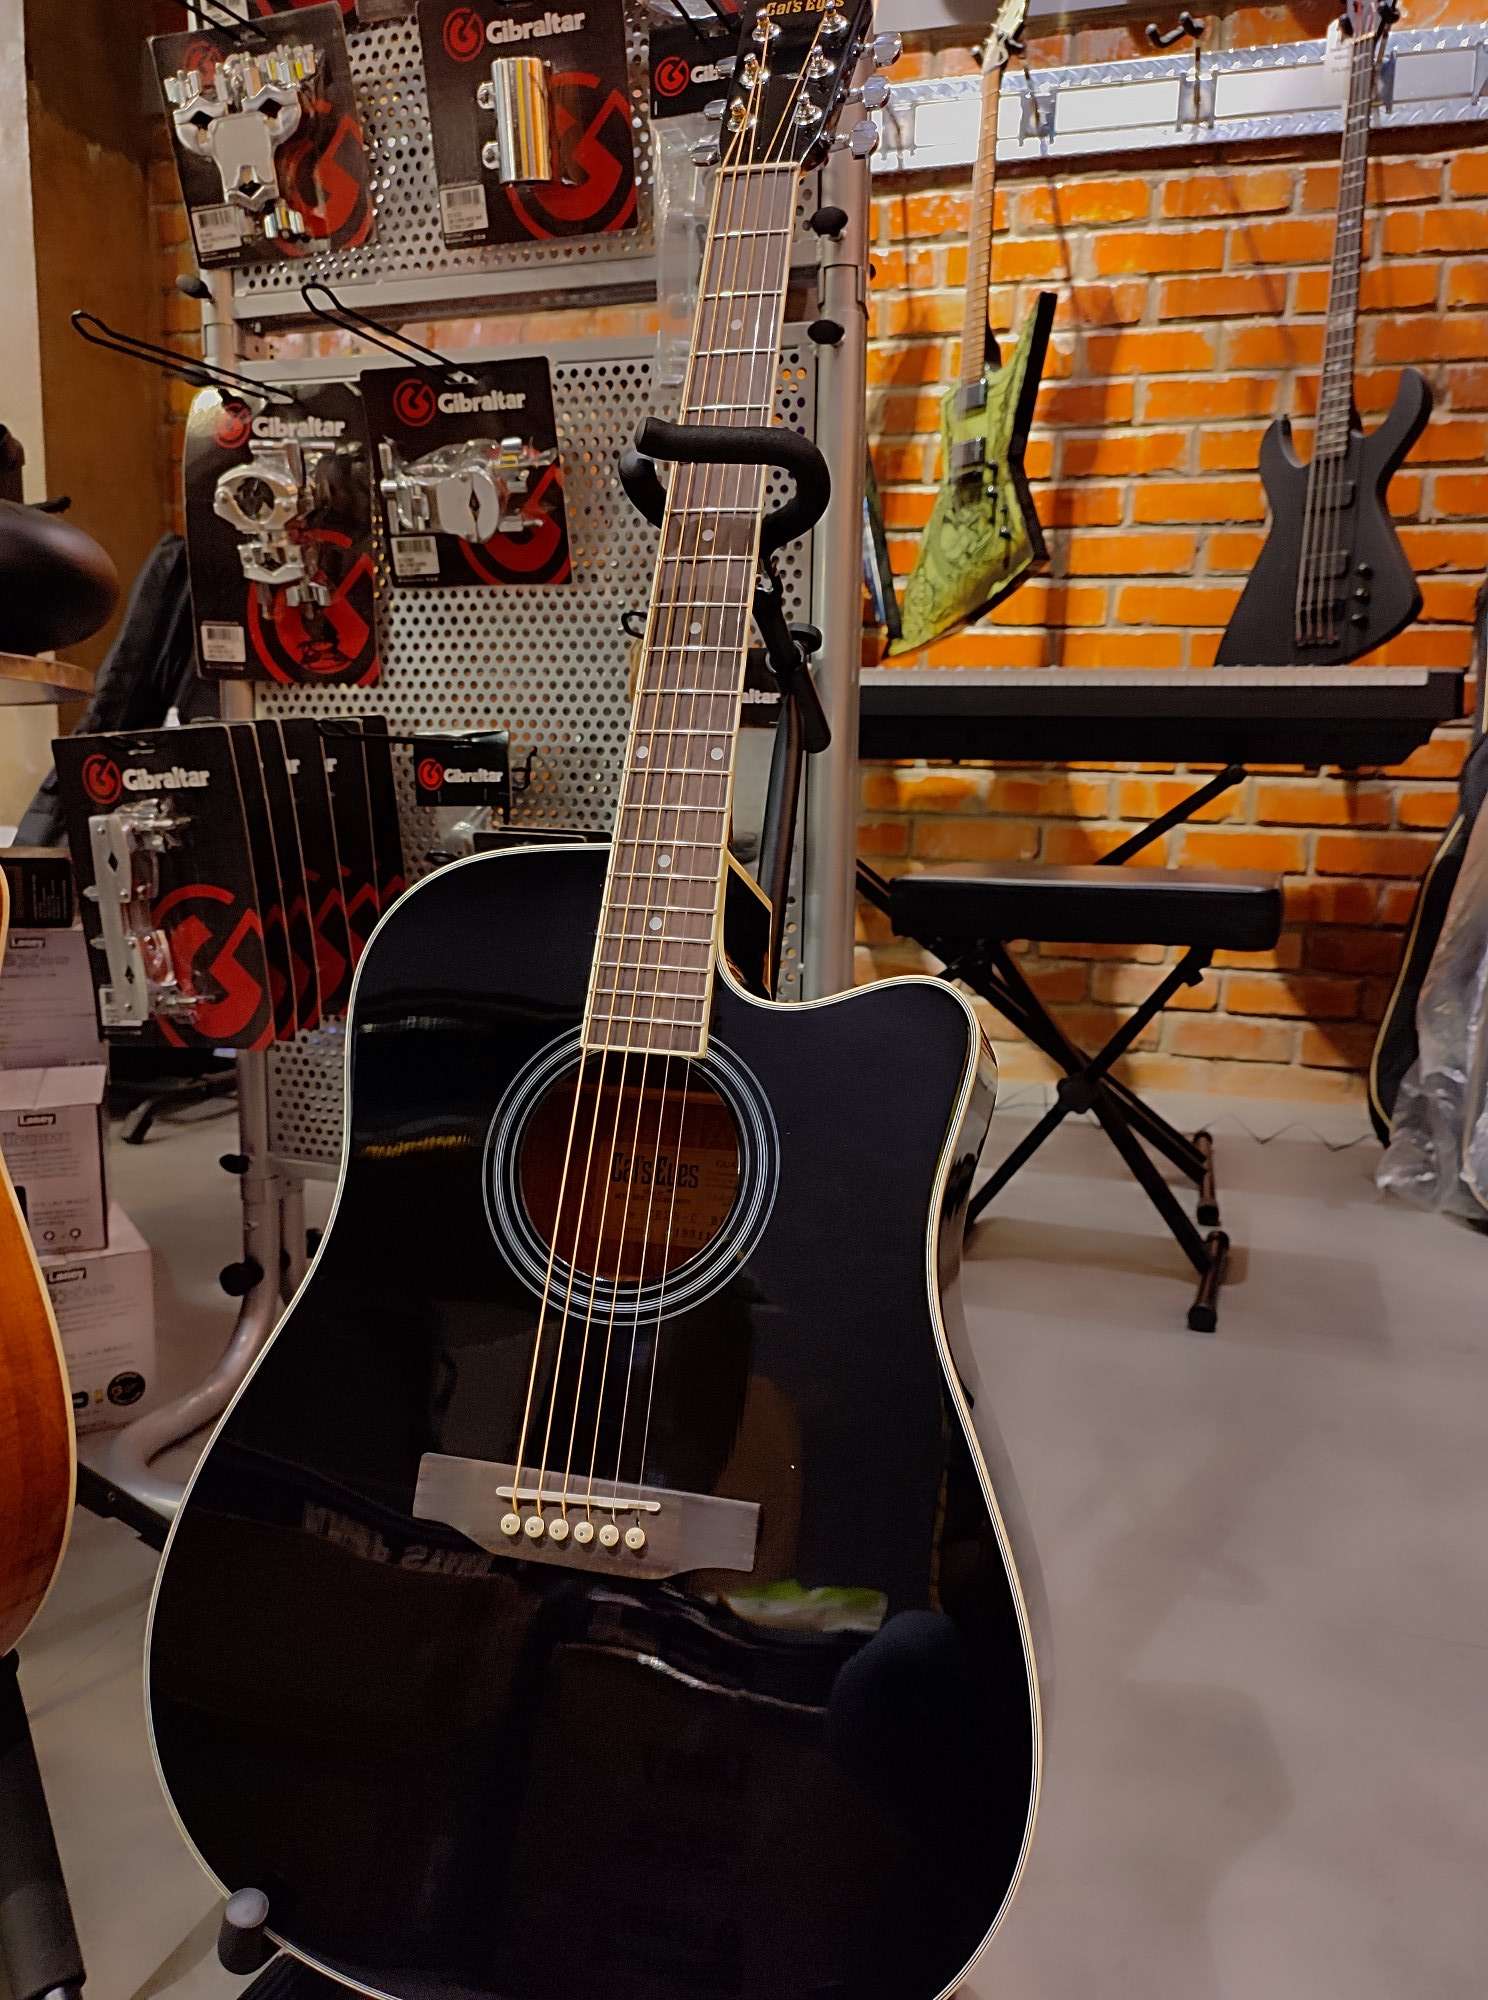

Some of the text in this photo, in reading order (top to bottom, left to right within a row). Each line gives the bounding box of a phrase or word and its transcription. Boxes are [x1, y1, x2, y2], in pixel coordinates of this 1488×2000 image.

[486, 12, 586, 44] Gibraltar
[438, 390, 526, 414] Gibraltar
[251, 416, 346, 439] Gibraltar
[122, 766, 210, 791] Gibraltar
[443, 768, 504, 783] Gibraltar
